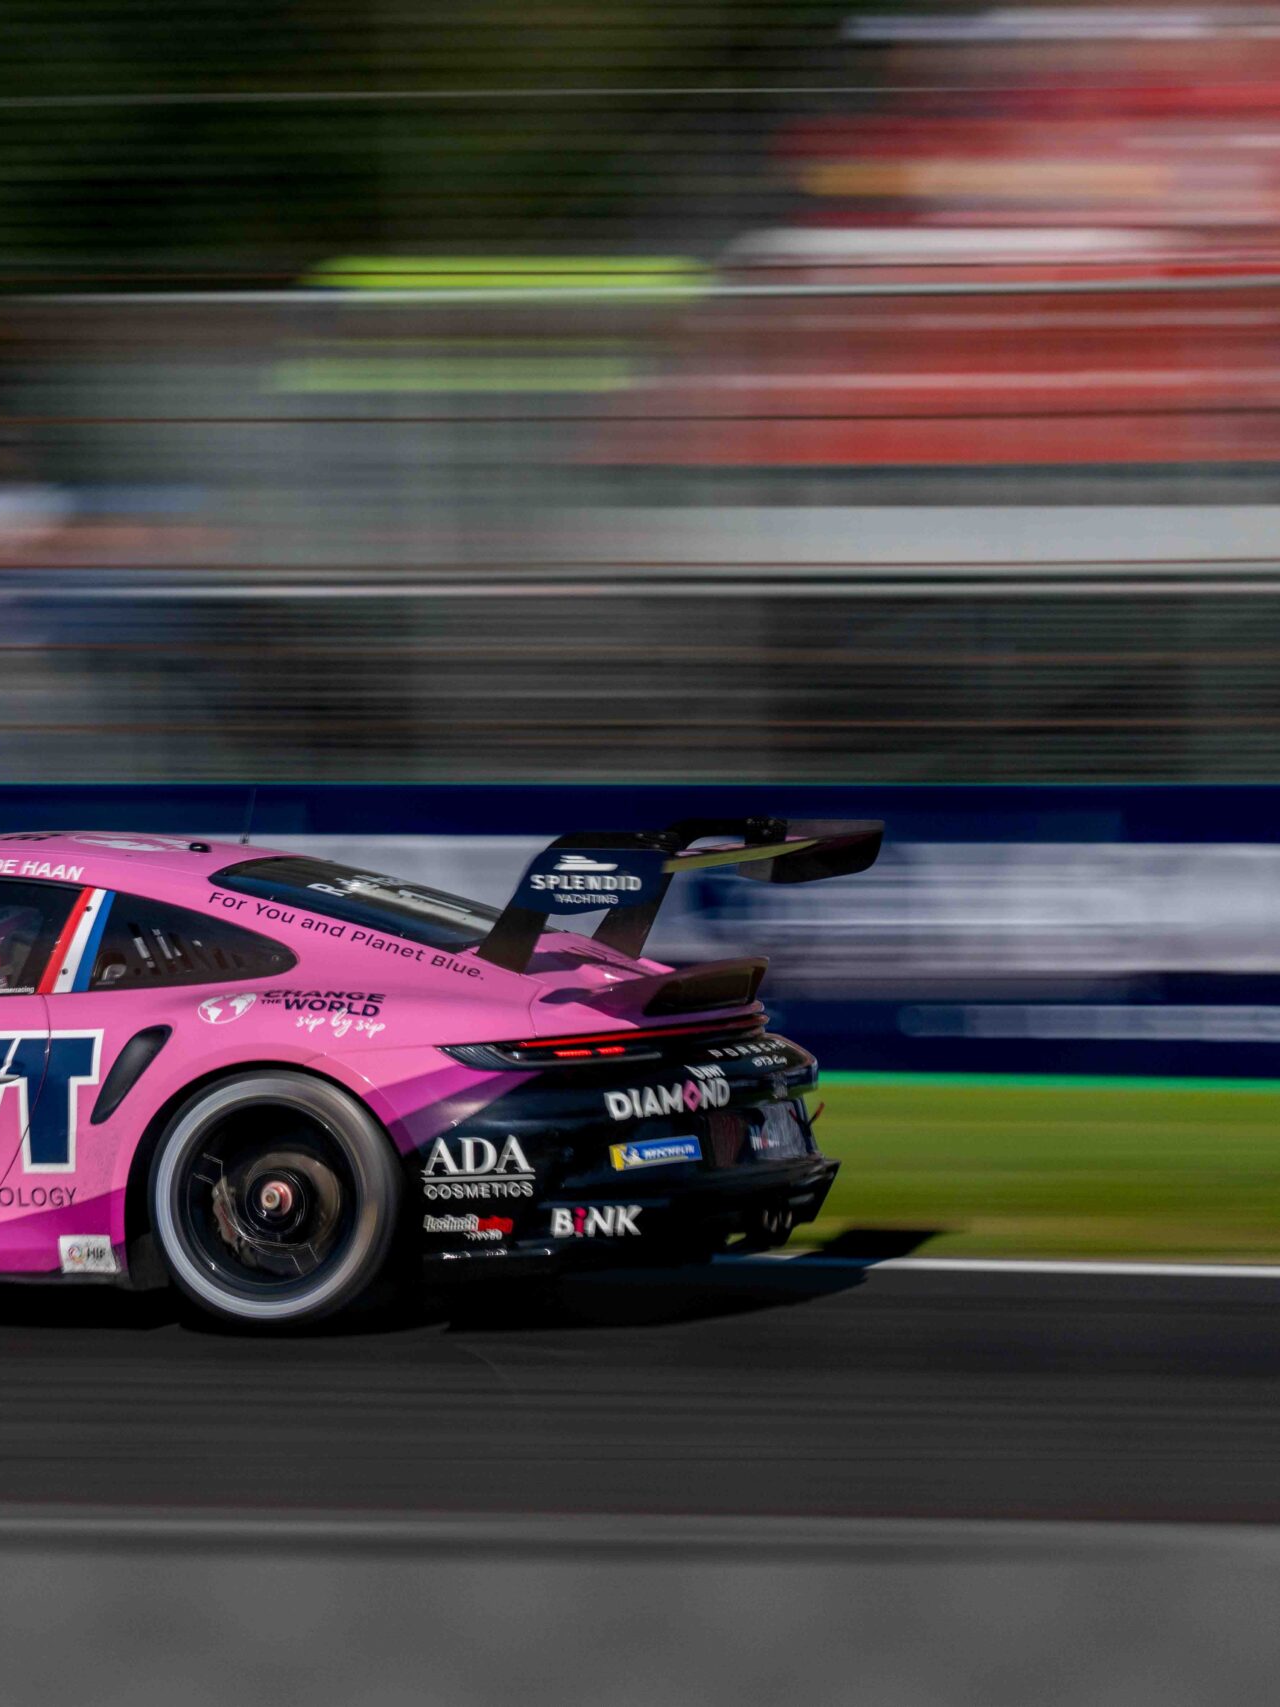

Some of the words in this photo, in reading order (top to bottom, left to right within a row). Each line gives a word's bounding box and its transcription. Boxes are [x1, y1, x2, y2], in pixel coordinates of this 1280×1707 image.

[22, 860, 85, 881] HAAN
[530, 874, 642, 891] SPLENDID
[553, 893, 619, 905] YACHTING
[208, 891, 247, 910] For
[256, 902, 295, 924] You
[301, 916, 346, 938] and
[350, 930, 426, 962] Planet
[431, 954, 485, 981] Blue.
[263, 989, 387, 1004] CHANGE
[284, 998, 381, 1017] WORLD
[296, 1013, 326, 1033] sip
[331, 1007, 353, 1038] by
[355, 1018, 386, 1038] sip
[604, 1077, 731, 1121] DIAMOND
[421, 1134, 536, 1176] ADA
[424, 1181, 534, 1200] COSMETICS
